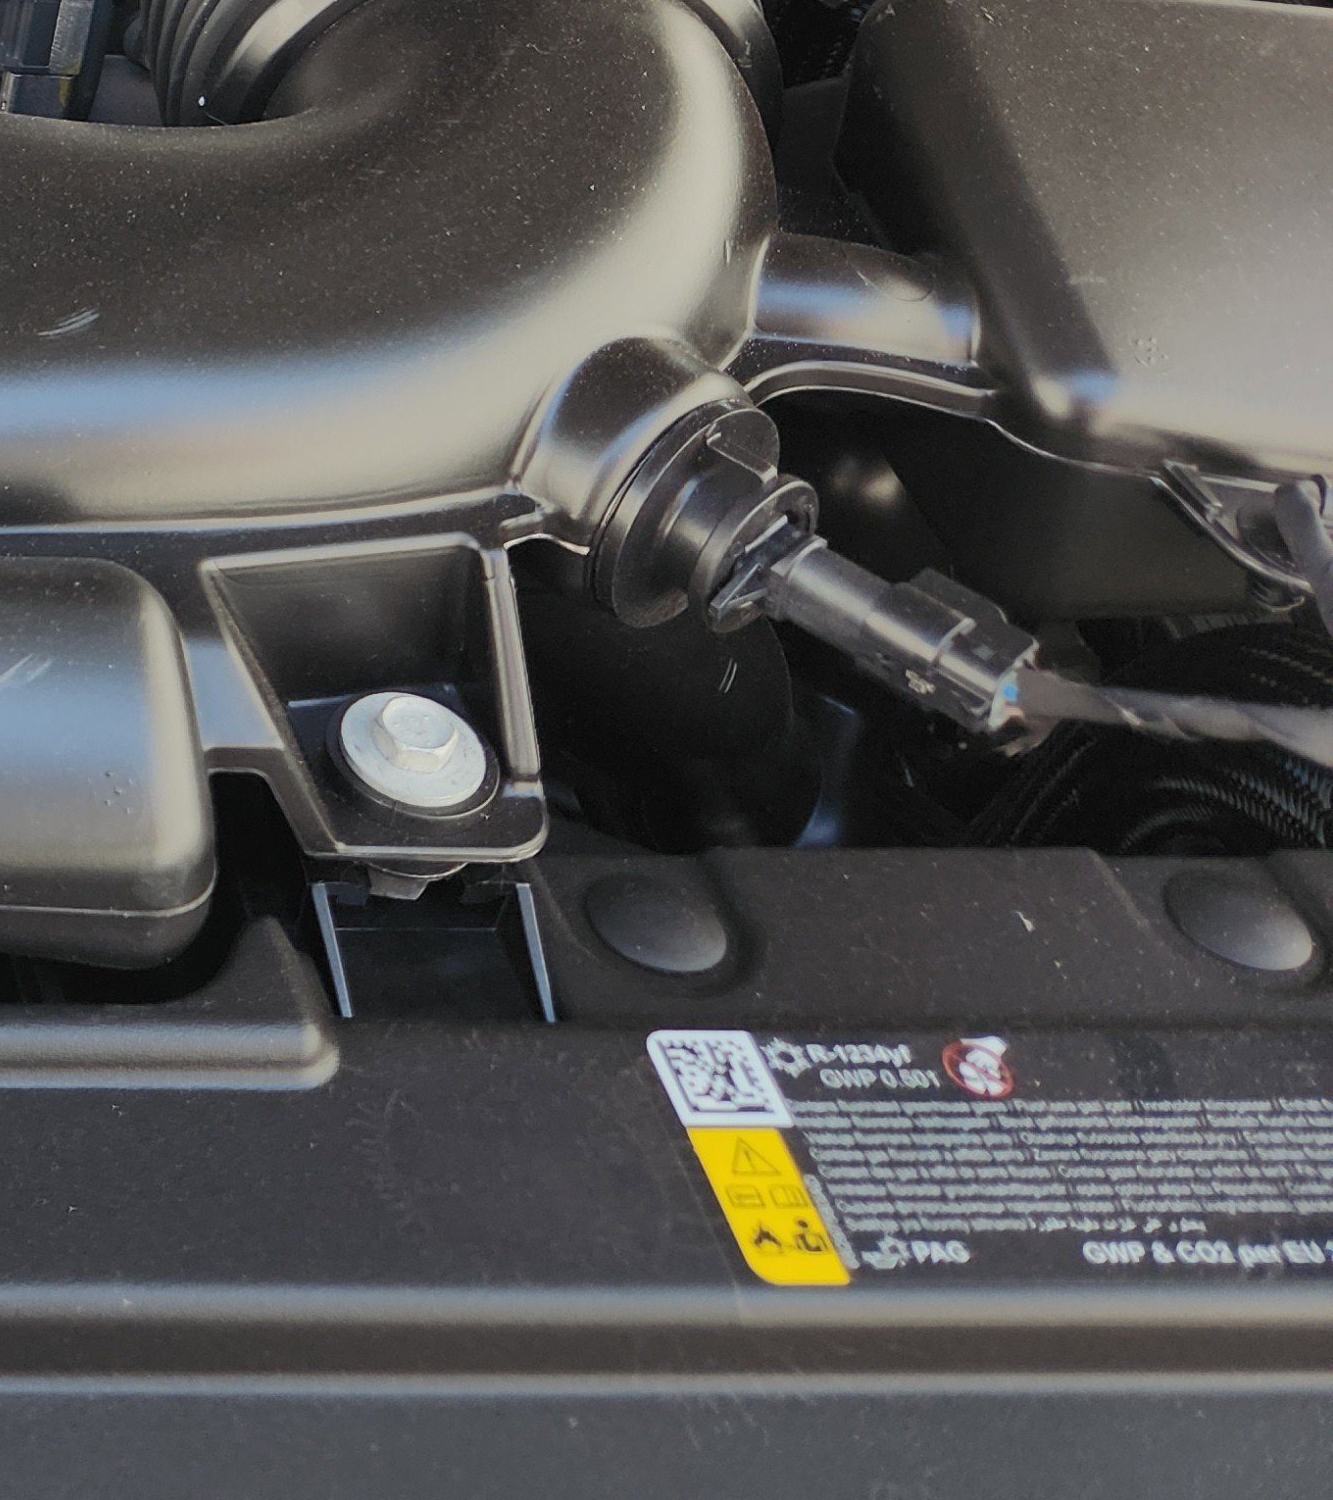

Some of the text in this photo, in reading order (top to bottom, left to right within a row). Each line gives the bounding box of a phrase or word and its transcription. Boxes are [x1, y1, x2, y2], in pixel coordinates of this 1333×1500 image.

[819, 1068, 878, 1089] GWP
[910, 1240, 971, 1264] PAG
[1082, 1239, 1326, 1268] GWP & CO2 per EU
